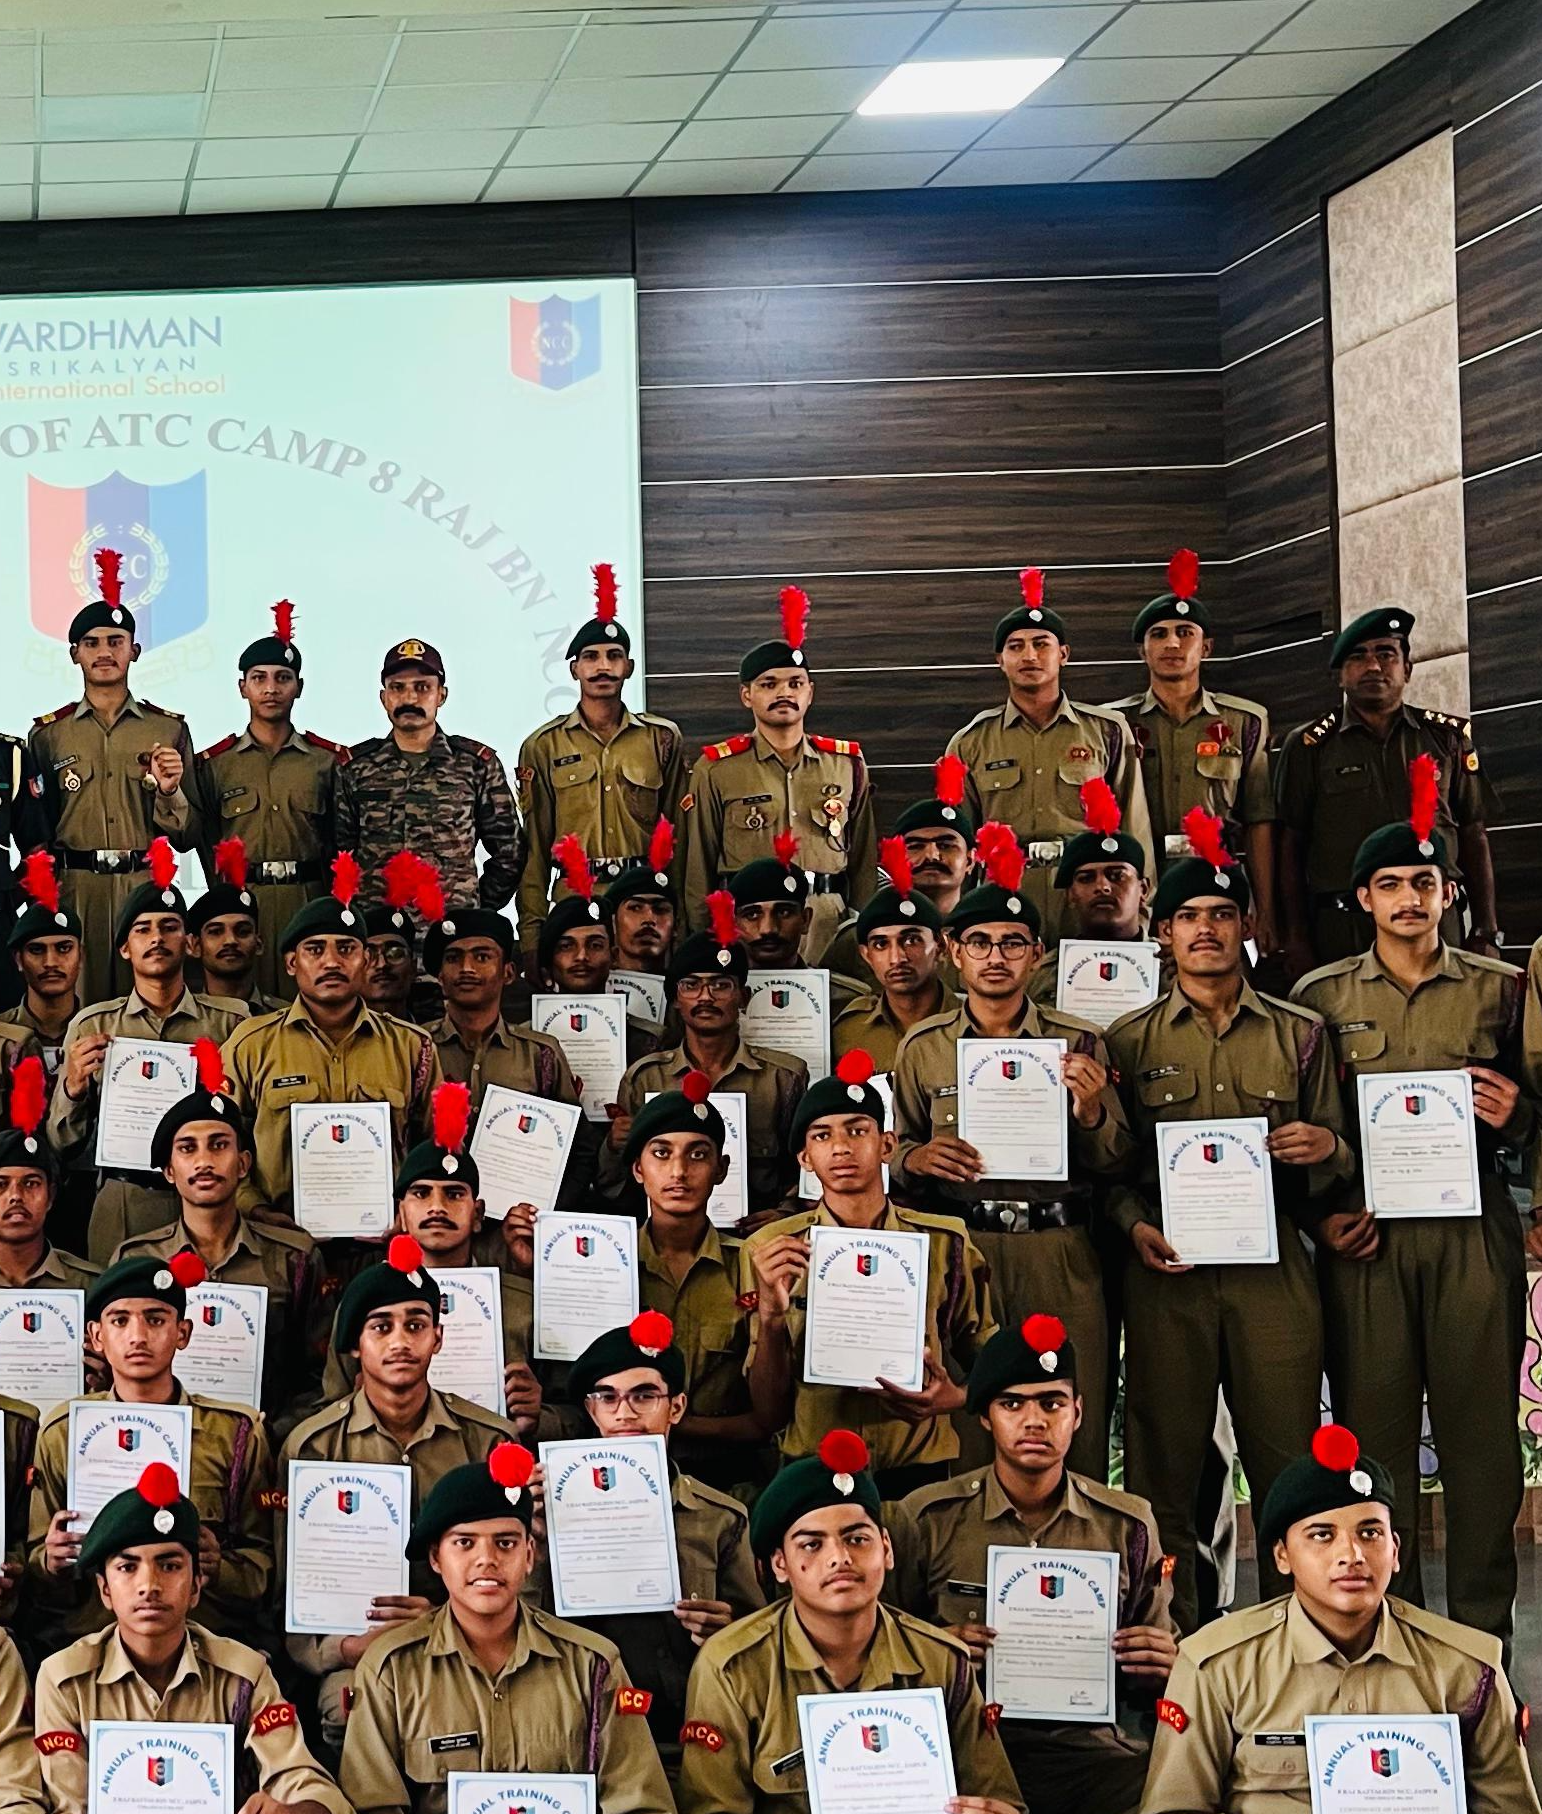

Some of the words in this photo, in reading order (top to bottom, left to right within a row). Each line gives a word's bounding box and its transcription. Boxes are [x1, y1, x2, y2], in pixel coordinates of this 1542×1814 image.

[7, 355, 198, 377] SRIKALYAN
[145, 375, 226, 397] School
[0, 417, 73, 458] OF
[84, 413, 193, 449] ATC
[208, 418, 366, 478] CAMP
[368, 460, 402, 494] 8
[401, 475, 504, 551] RAJ
[488, 545, 557, 612] BN
[818, 1246, 849, 1281] ANNUAL
[849, 1241, 899, 1259] TRAINING
[900, 1259, 917, 1287] CAMP
[439, 1279, 473, 1295] AINING
[15, 1300, 60, 1315] TRAINING
[79, 1420, 110, 1456] ANNUAL
[111, 1415, 162, 1433] TRAINING
[162, 1433, 179, 1463] CAMP
[554, 1461, 582, 1501] ANNUAL
[582, 1451, 637, 1467] TRAINING
[638, 1467, 659, 1495] CAMP
[298, 1481, 328, 1520] ANNUAL
[329, 1476, 382, 1495] TRAINING
[382, 1495, 399, 1525] CAMP
[998, 1567, 1031, 1604] ANNUAL
[1032, 1560, 1087, 1579] TRAINING
[1087, 1579, 1106, 1609] CAMP
[260, 1708, 290, 1731] NCC
[1160, 1704, 1183, 1729] NCC
[43, 1734, 74, 1751] NCC
[686, 1728, 720, 1745] NCC
[818, 1718, 849, 1765] ANNUAL
[848, 1707, 912, 1726] TRAINING
[913, 1725, 939, 1758] CAMP
[100, 1748, 137, 1794] ANNUAL
[138, 1739, 199, 1760] TRAINING
[200, 1760, 222, 1797] CAMP
[1322, 1740, 1357, 1787] ANNUAL
[1358, 1730, 1425, 1751] TRAINING
[1426, 1751, 1452, 1786] CAMP
[498, 1789, 561, 1810] TRAINING
